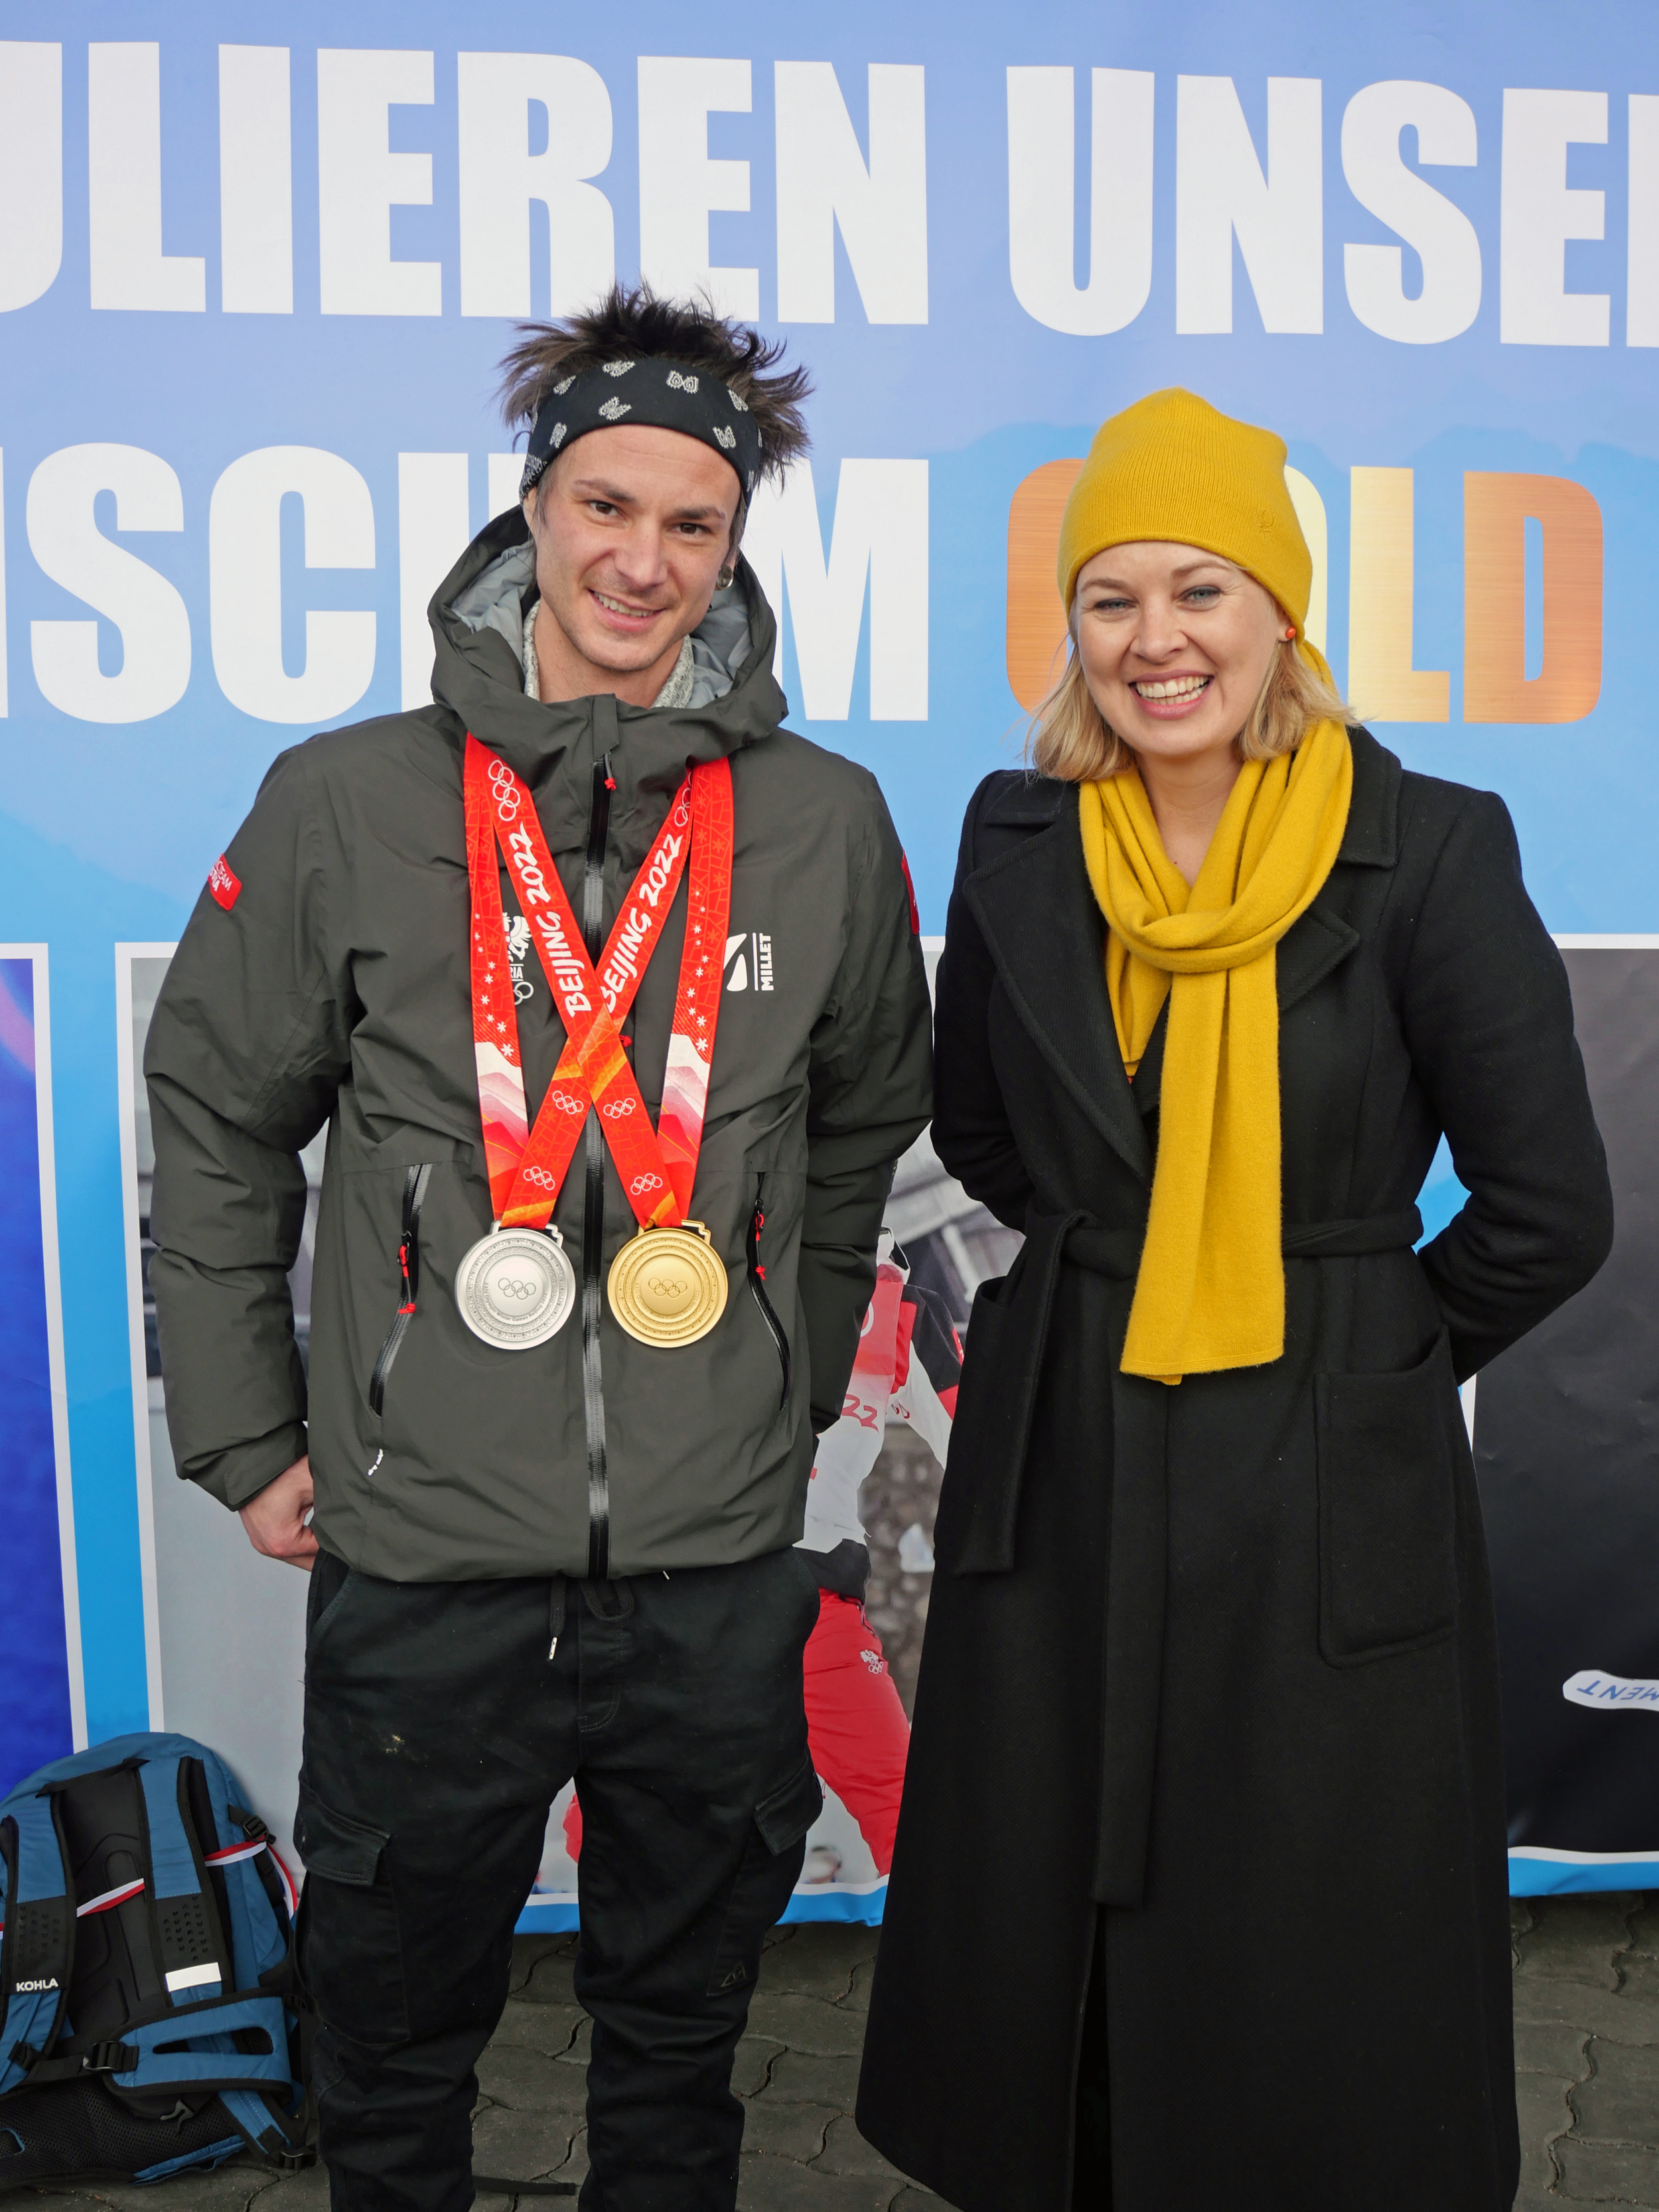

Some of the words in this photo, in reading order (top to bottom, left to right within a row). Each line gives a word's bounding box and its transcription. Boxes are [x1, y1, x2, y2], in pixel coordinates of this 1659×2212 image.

[1006, 458, 1604, 725] LD
[509, 821, 551, 906] 2022
[639, 834, 683, 907] 2022
[536, 911, 592, 1018] BEIJING
[759, 932, 774, 992] MILLET
[16, 1978, 59, 1992] KOHLA
